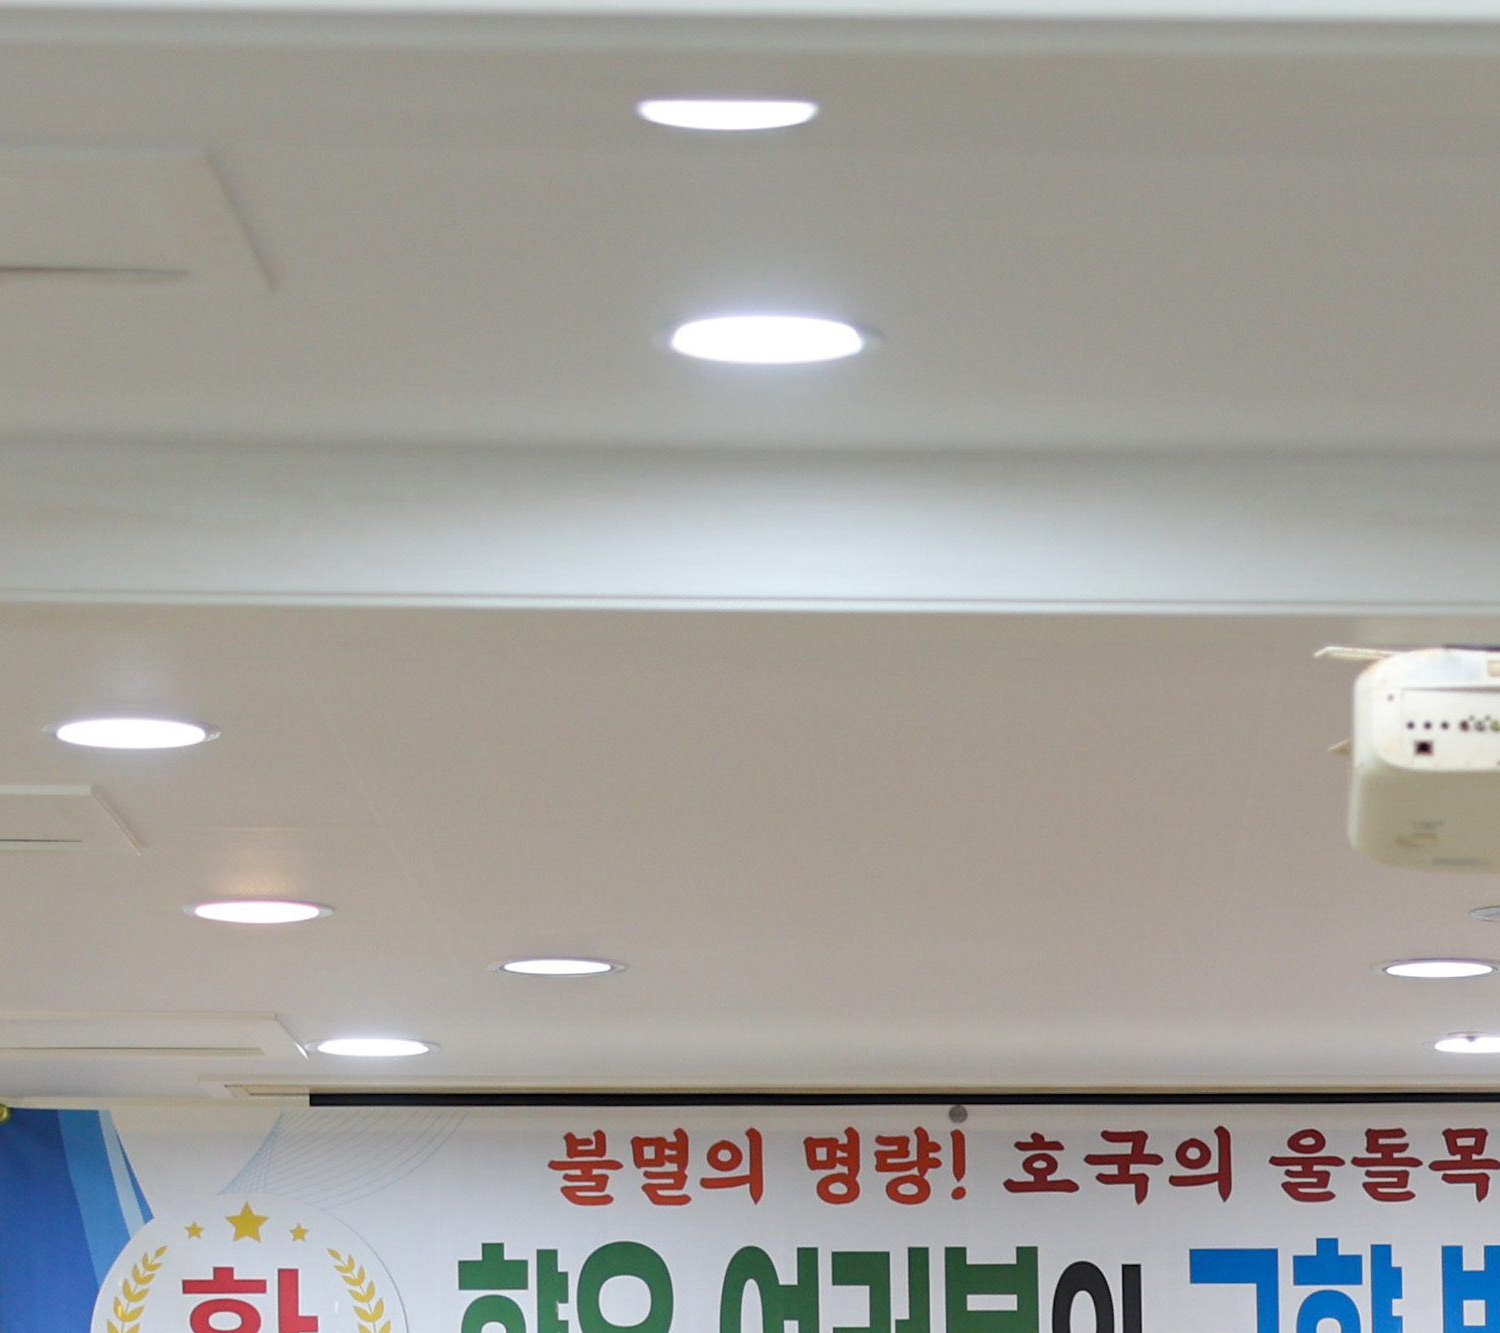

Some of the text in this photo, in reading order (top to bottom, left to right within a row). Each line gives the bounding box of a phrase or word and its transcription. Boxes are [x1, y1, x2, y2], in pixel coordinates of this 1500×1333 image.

[549, 1129, 762, 1205] 불멸의
[804, 1126, 967, 1204] 명량!
[1003, 1126, 1231, 1204] 호국의
